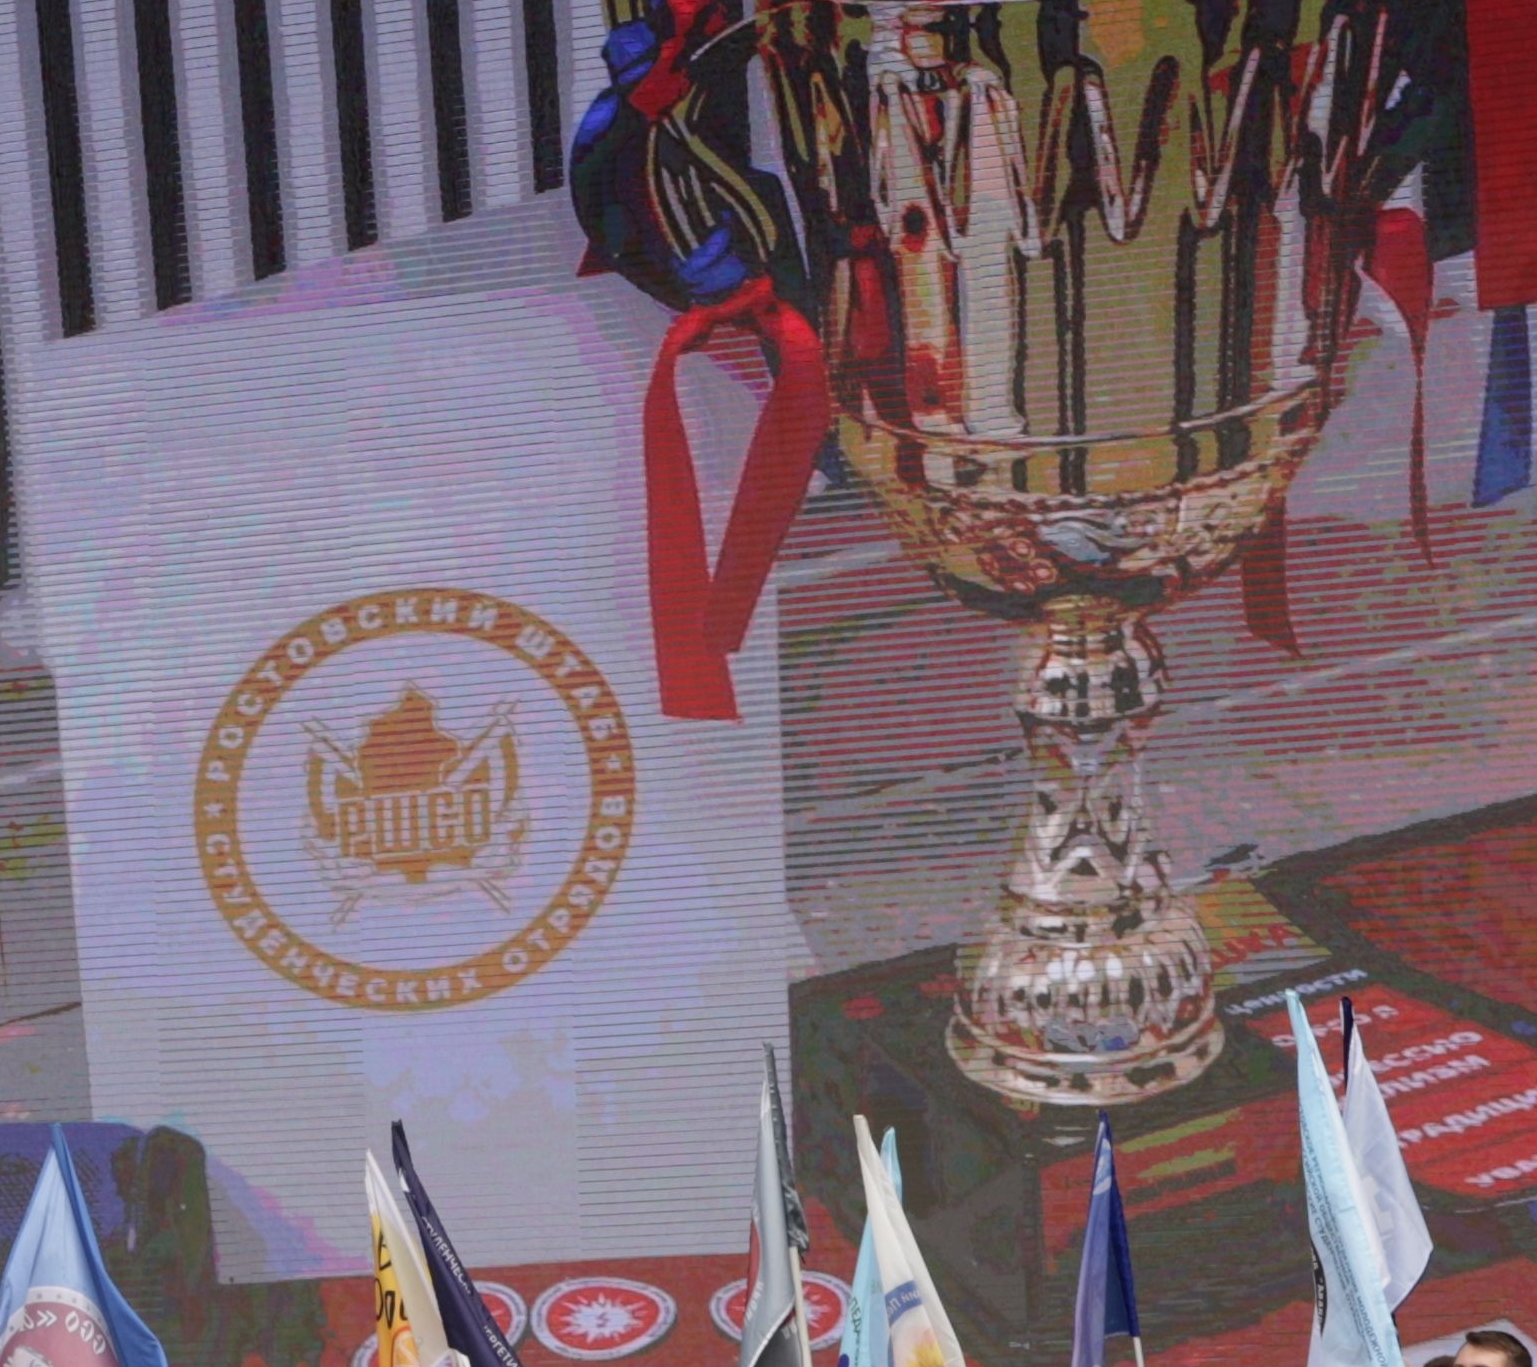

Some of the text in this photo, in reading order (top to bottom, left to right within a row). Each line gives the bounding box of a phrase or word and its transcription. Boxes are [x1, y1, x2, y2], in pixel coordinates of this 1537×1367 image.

[205, 596, 622, 782] РОСТОВСКИЙ ШТАБ
[205, 796, 628, 1005] СТУДЕНЧЕСКИХ ОТРЯДОВ
[338, 784, 493, 860] РШСО
